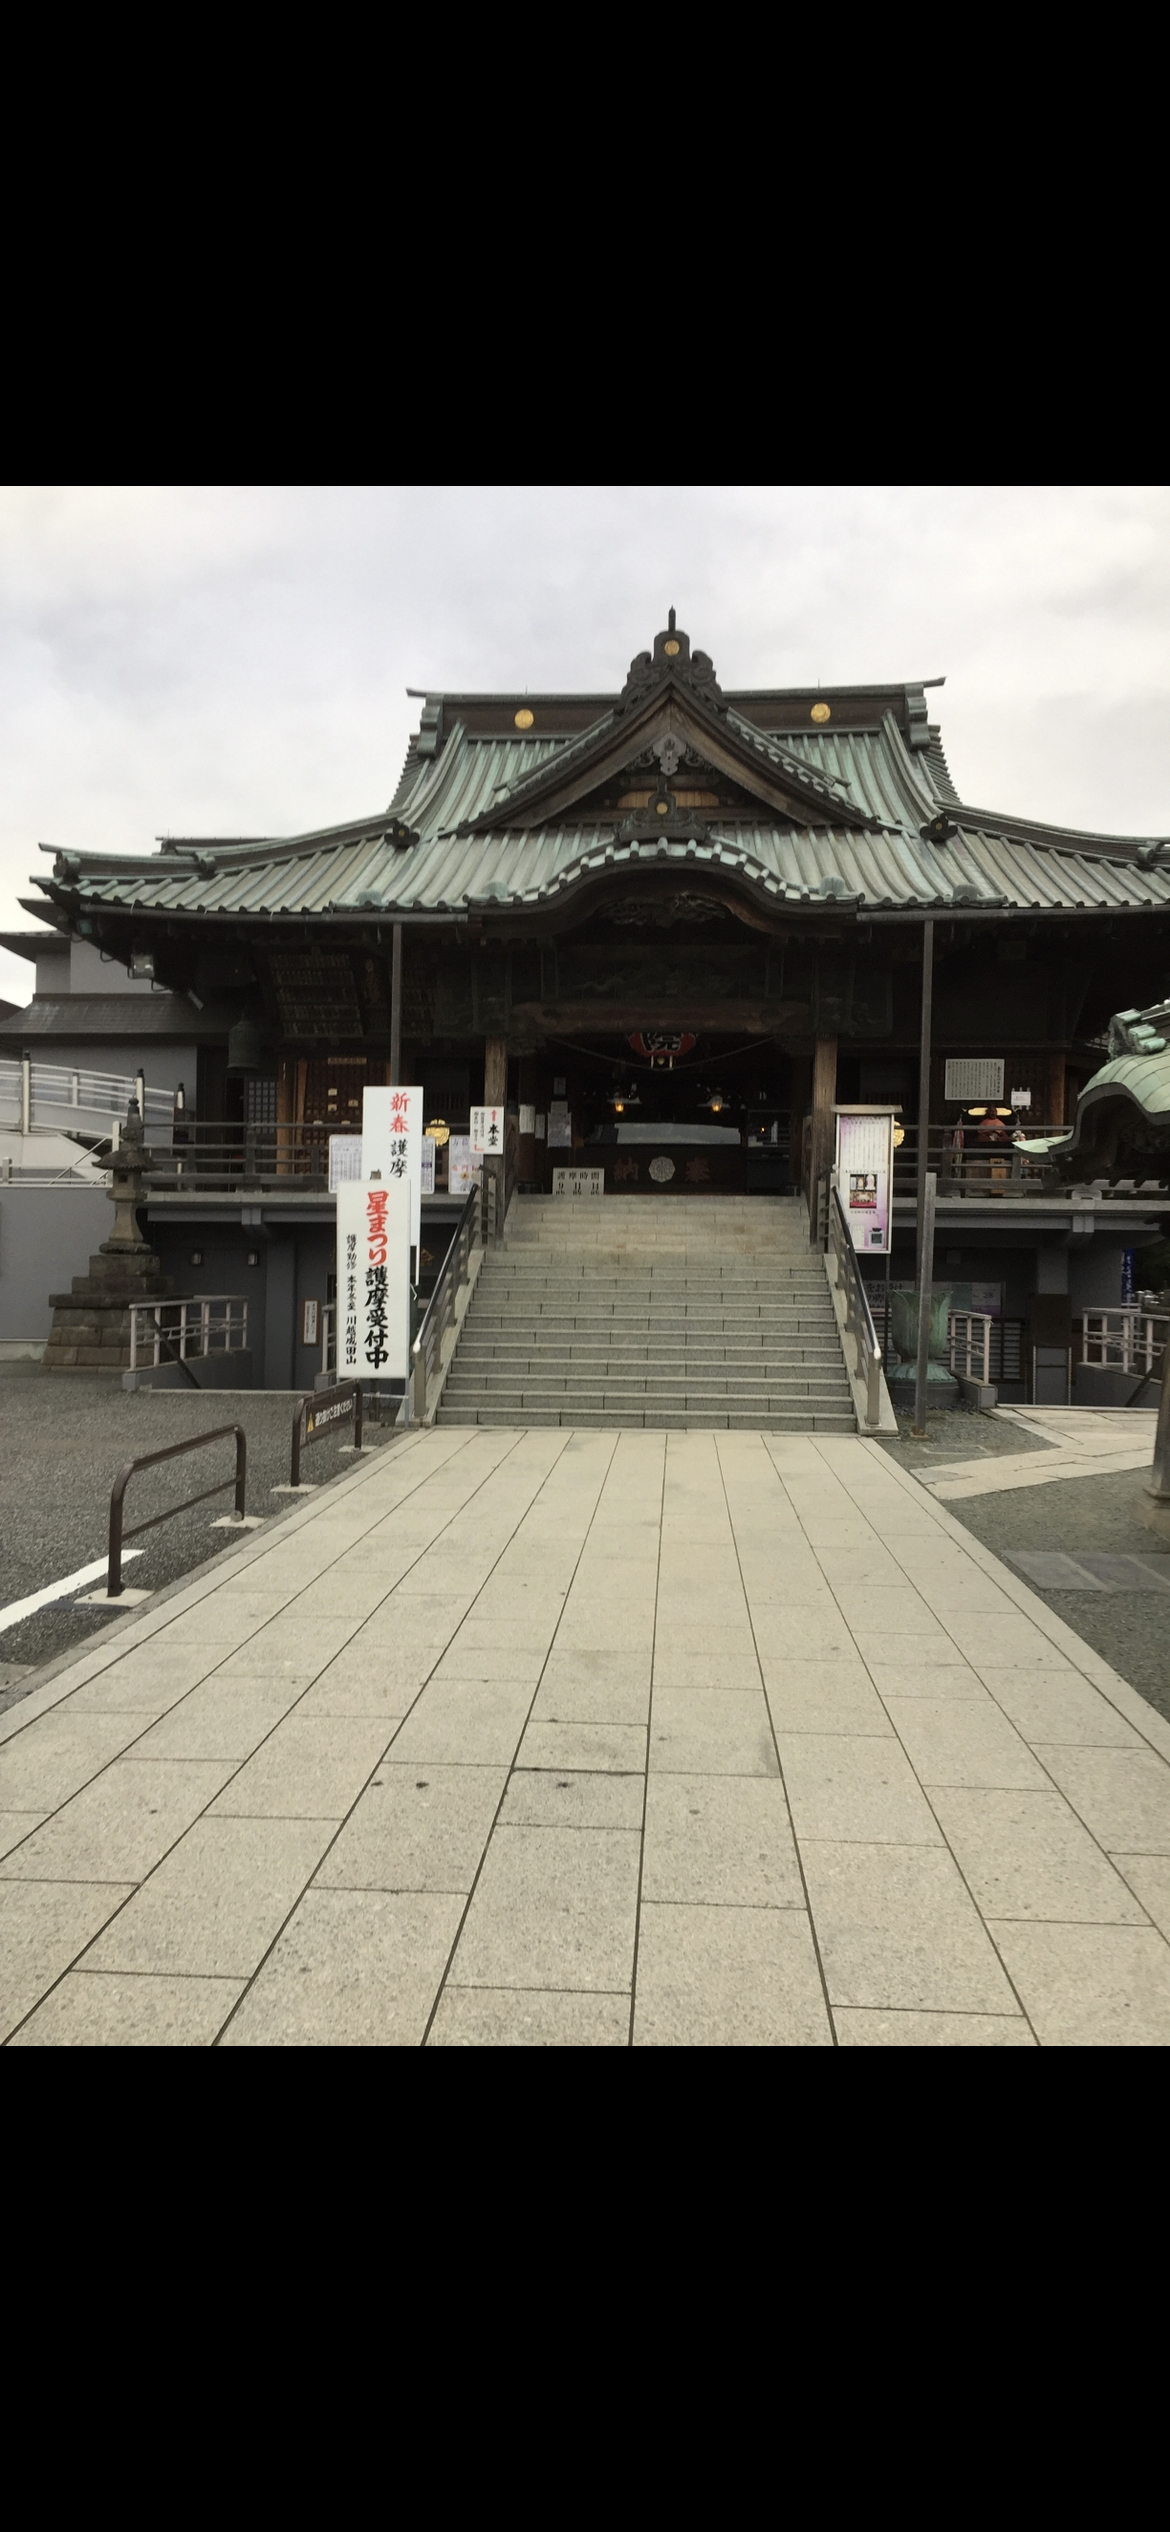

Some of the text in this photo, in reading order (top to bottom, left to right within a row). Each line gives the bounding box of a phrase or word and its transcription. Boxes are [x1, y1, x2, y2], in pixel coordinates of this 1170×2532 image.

[389, 1092, 411, 1178] 新春 護摩
[488, 1123, 500, 1148] 本堂
[364, 1190, 390, 1370] 星まつり護摩受付中
[345, 1315, 357, 1365] 川越成田山
